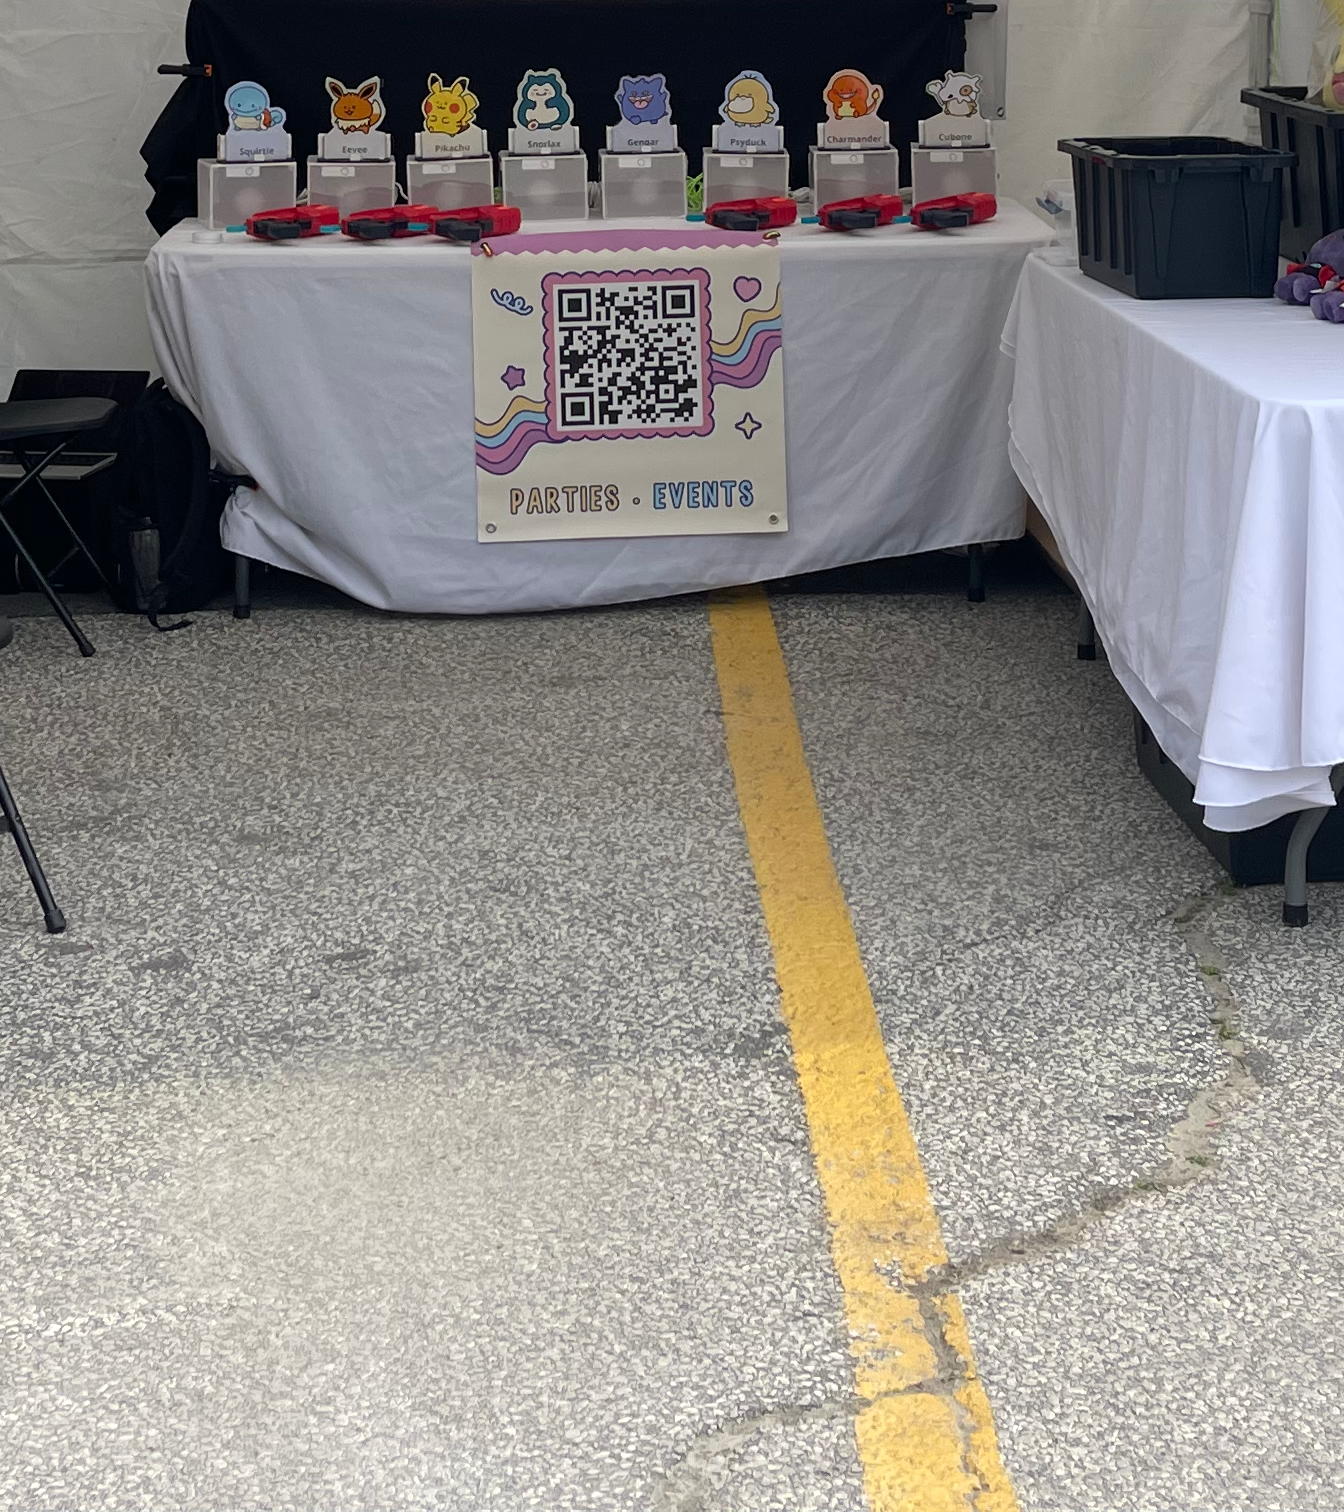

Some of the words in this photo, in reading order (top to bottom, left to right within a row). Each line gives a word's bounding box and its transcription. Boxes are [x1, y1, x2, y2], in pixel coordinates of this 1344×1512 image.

[826, 134, 882, 144] Charmander
[938, 132, 972, 142] Cubone
[527, 140, 561, 149] Snorlax
[627, 138, 659, 148] Gengar
[730, 137, 767, 148] Psyduck
[239, 146, 275, 157] Squirtle
[342, 145, 368, 154] Eevee
[434, 143, 471, 153] Pikachu
[509, 484, 620, 515] PARTIES
[652, 479, 754, 510] EVENTS
